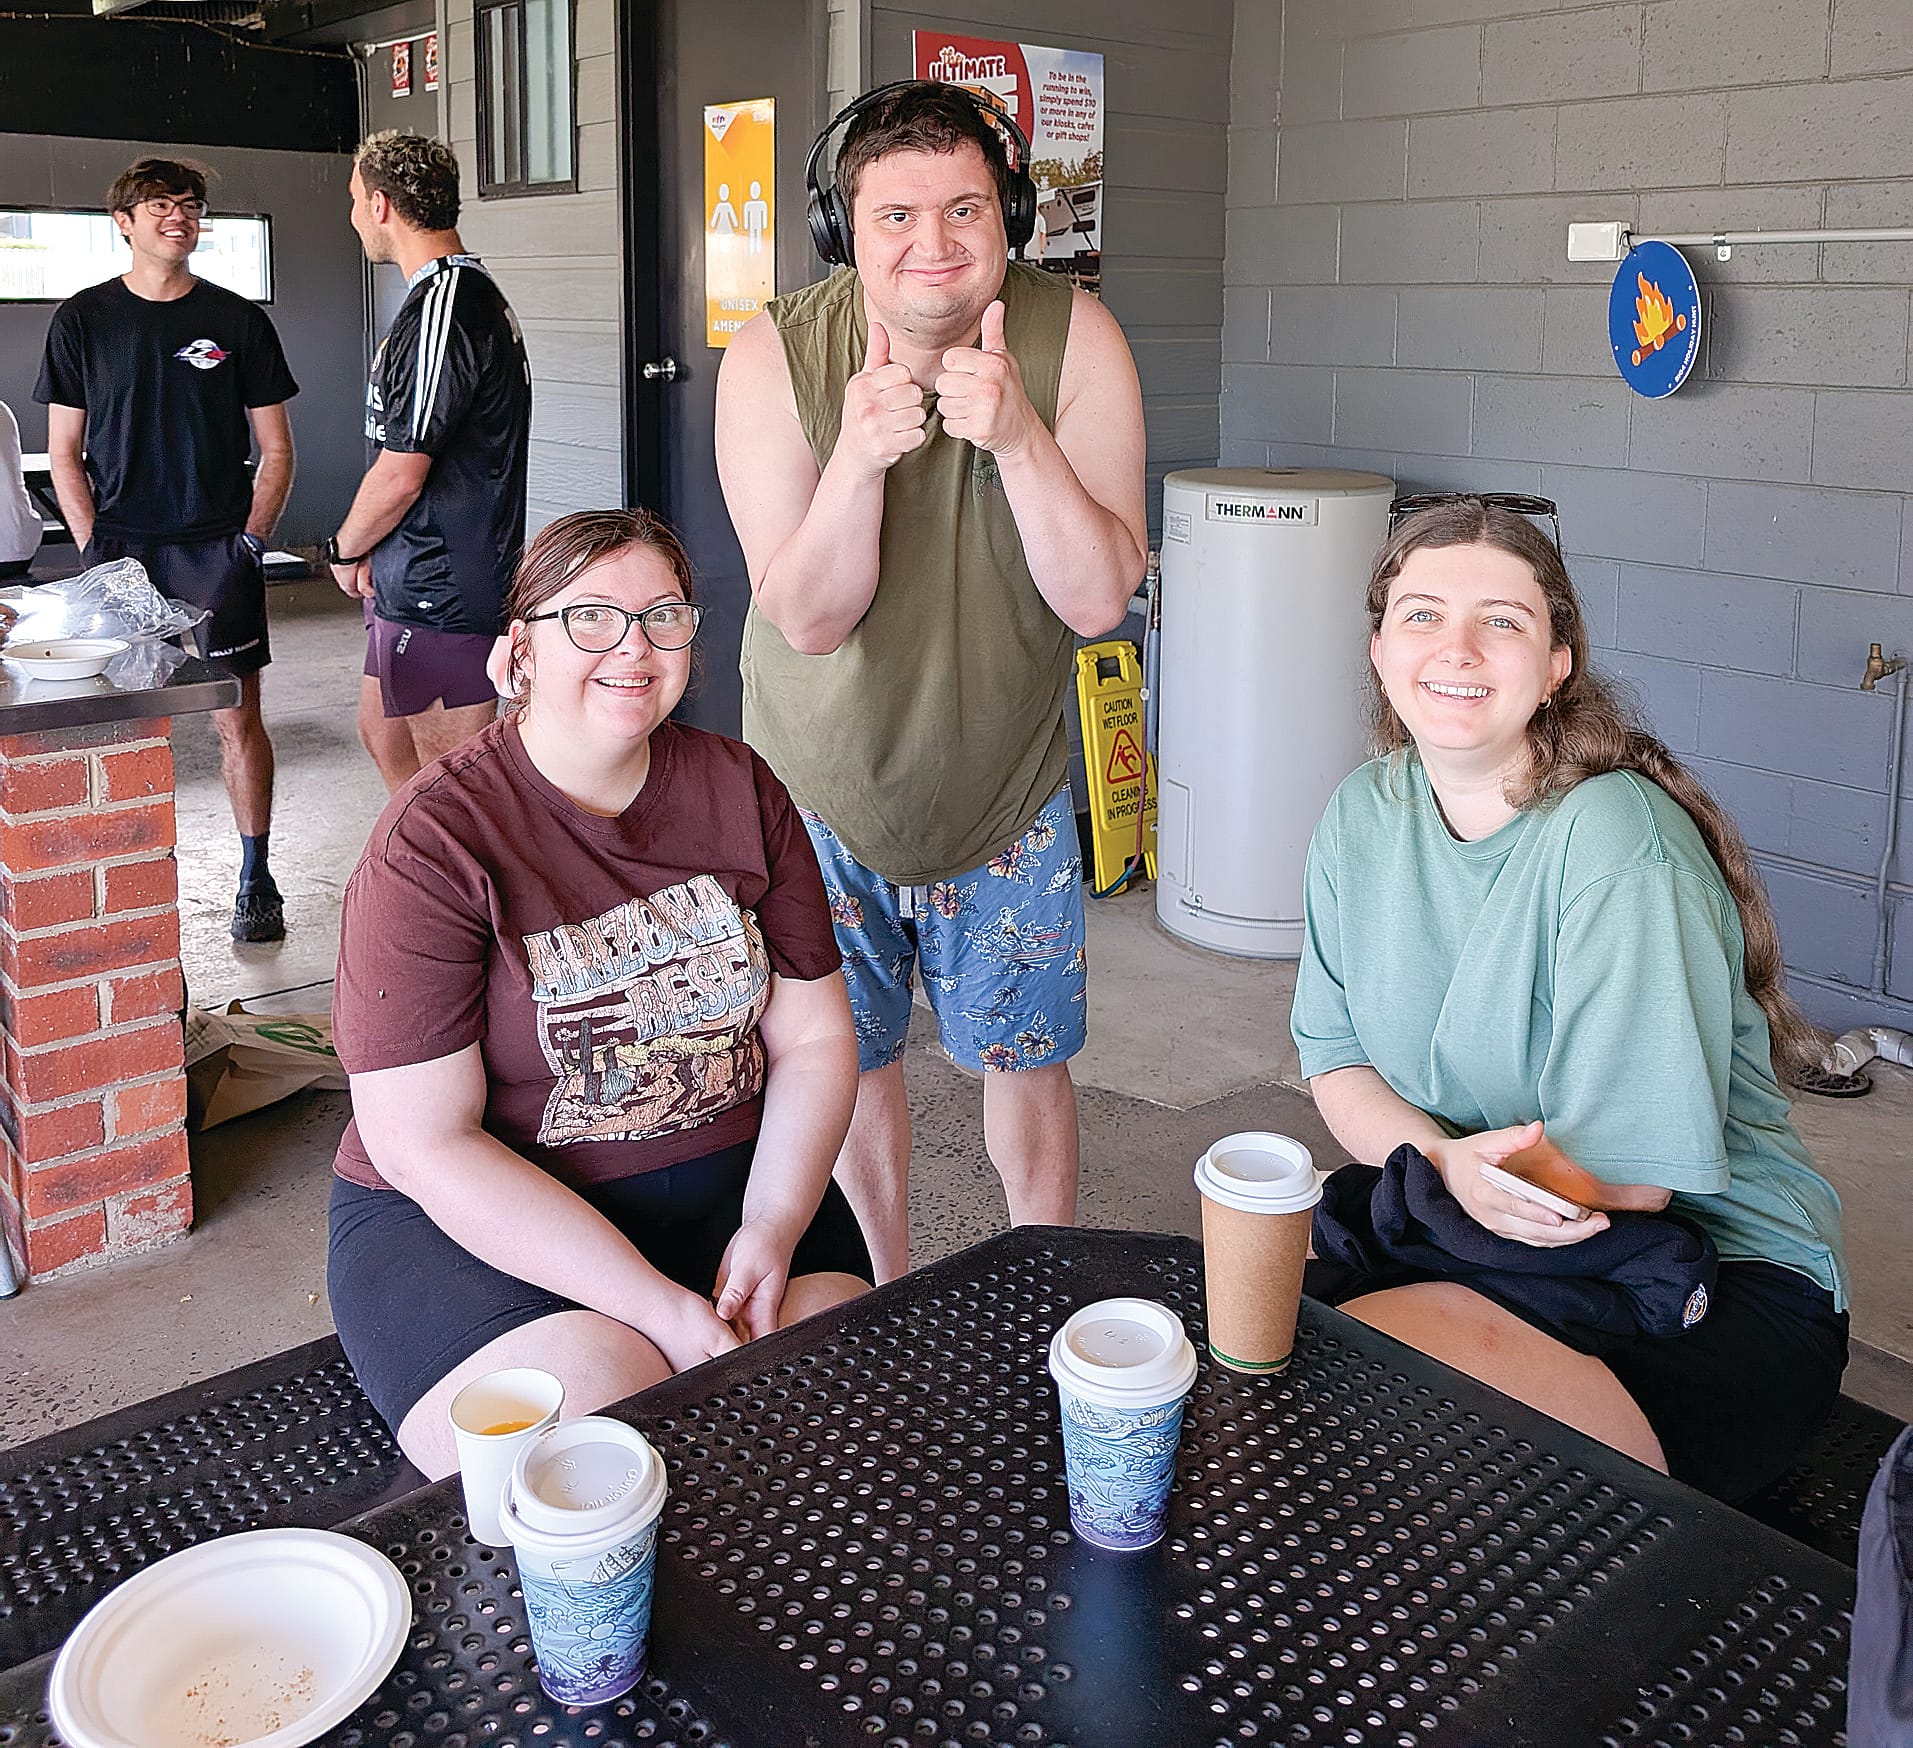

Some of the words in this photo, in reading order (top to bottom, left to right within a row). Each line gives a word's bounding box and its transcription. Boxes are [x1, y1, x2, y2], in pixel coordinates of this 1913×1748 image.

[931, 58, 1004, 82] ULTIMATE
[1049, 72, 1057, 80] To
[1058, 72, 1067, 81] be
[1068, 73, 1074, 82] in
[1076, 74, 1087, 83] the
[1043, 84, 1069, 94] running
[1071, 86, 1077, 94] to
[1039, 94, 1061, 105] simply
[1063, 97, 1083, 107] spend
[1049, 108, 1067, 116] more
[1068, 108, 1074, 117] in
[1075, 110, 1087, 119] any
[1088, 111, 1096, 119] of
[1041, 119, 1052, 127] our
[1046, 131, 1054, 139] or
[1055, 131, 1067, 141] gift
[721, 298, 759, 312] UNISEX
[712, 319, 745, 333] AMEN
[1684, 329, 1697, 365] HOLIDAY
[1215, 502, 1303, 520] THERMANN
[1103, 697, 1133, 714] CAUTION
[1101, 716, 1116, 730] WET
[1116, 711, 1138, 728] FLOOR
[1107, 807, 1116, 820] IN
[522, 873, 745, 1001] ARIZONA
